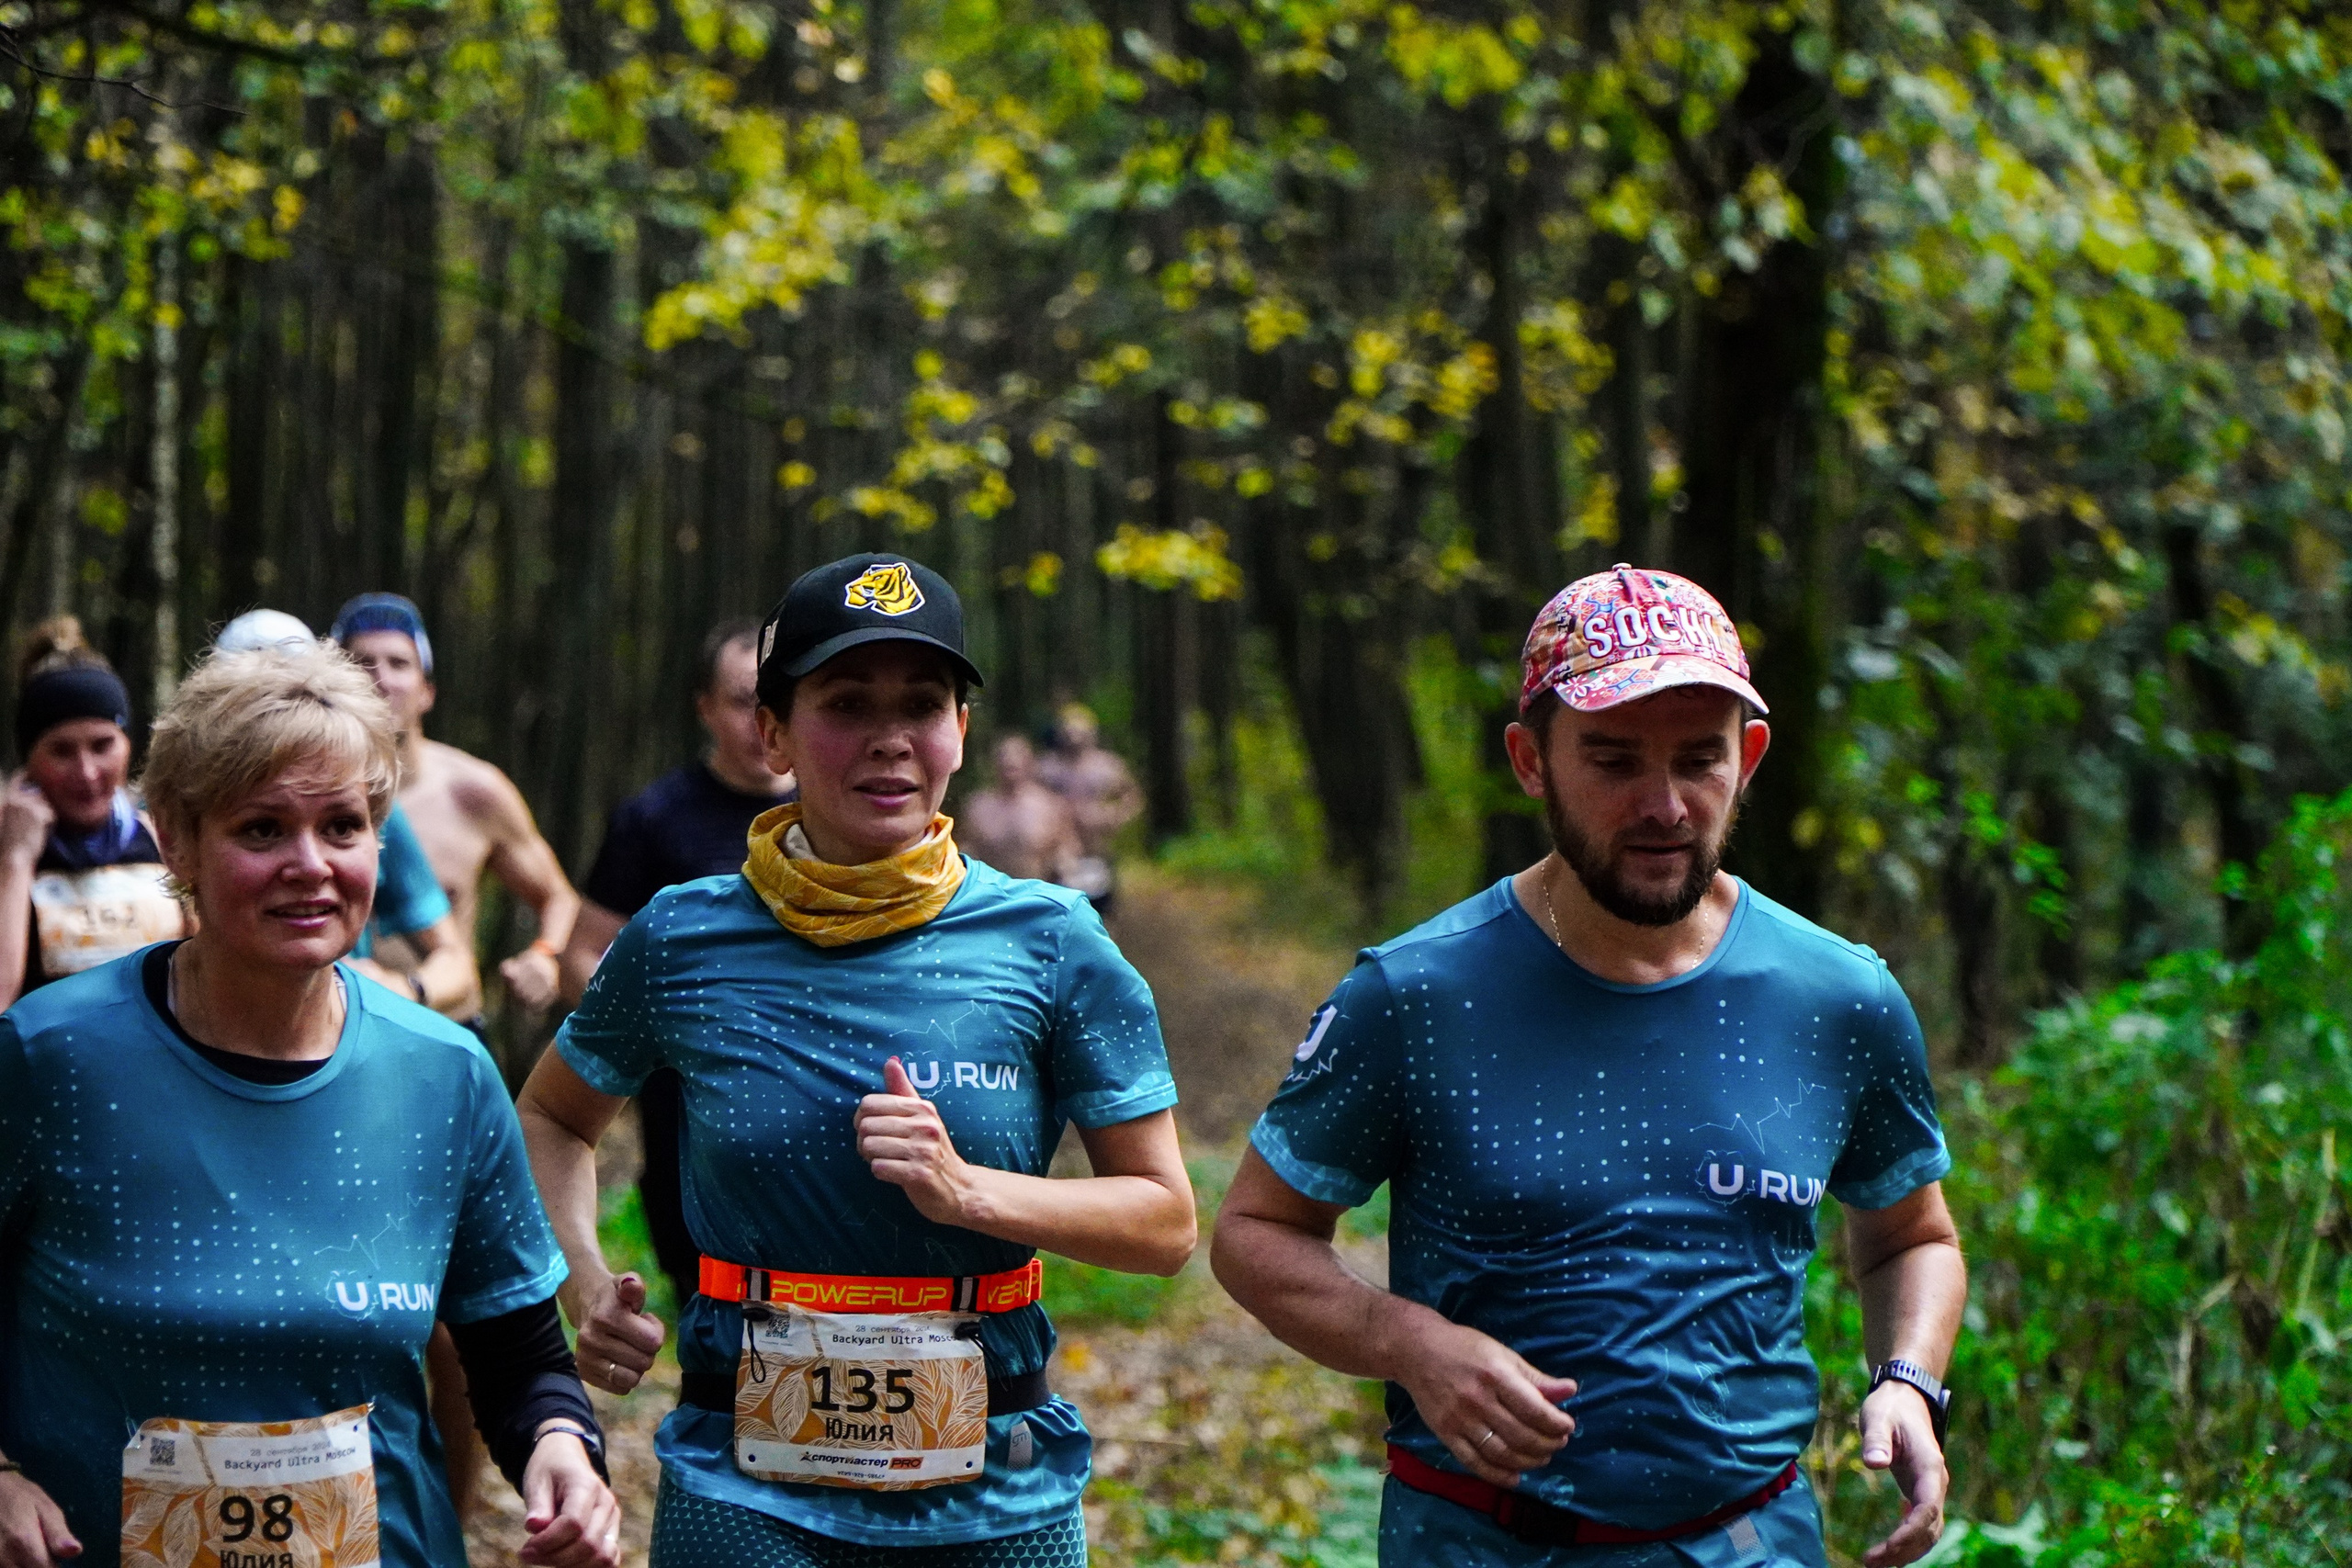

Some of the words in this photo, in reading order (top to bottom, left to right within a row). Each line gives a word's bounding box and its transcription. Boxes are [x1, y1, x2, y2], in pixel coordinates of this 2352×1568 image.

[1583, 604, 1725, 659] SOCHI
[908, 1060, 940, 1089] U
[954, 1061, 1020, 1091] RUN
[1709, 1163, 1744, 1195] U
[1759, 1168, 1827, 1208] RUN
[335, 1281, 368, 1312] U
[379, 1282, 435, 1312] RUN
[770, 1280, 947, 1307] POWERUP
[831, 1334, 885, 1347] Backyard
[891, 1335, 923, 1345] Ultra
[854, 1325, 866, 1333] 28
[810, 1366, 916, 1415] 135
[826, 1416, 895, 1442] Юлия
[224, 1459, 282, 1472] Backyard
[288, 1455, 321, 1467] Ultra
[325, 1447, 356, 1461] Moscow
[250, 1449, 262, 1457] 28
[811, 1453, 888, 1469] спортмастер
[890, 1458, 923, 1470] PRO
[220, 1494, 294, 1544] 98
[220, 1549, 294, 1568] Юлия
